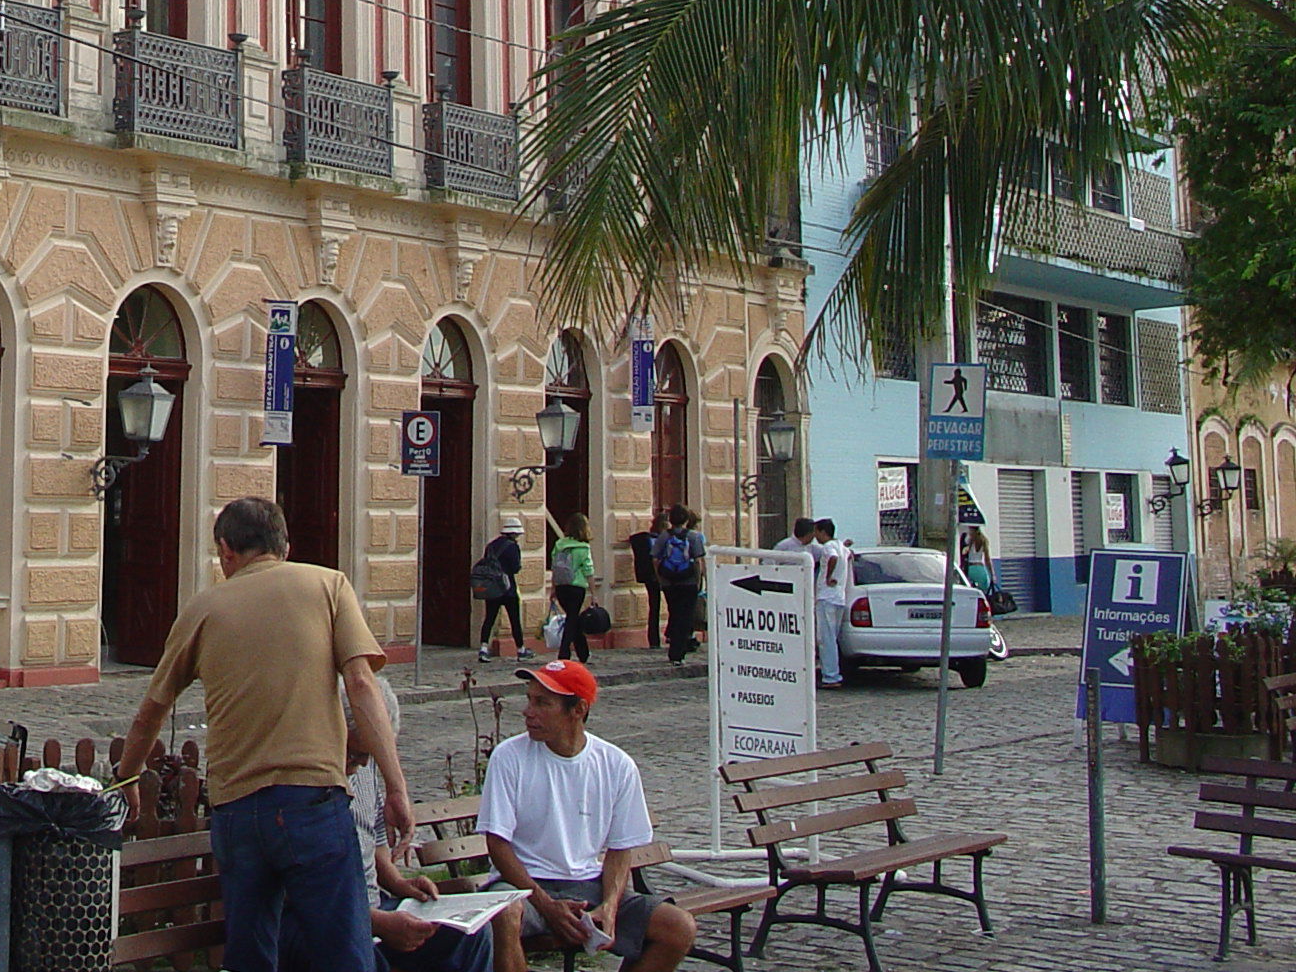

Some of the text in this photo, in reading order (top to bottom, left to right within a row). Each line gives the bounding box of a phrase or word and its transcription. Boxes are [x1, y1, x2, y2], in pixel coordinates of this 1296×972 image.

[416, 421, 426, 441] E
[929, 421, 983, 435] DEVAGAR
[928, 438, 982, 452] PEDESTRES
[726, 607, 801, 635] ILHA DO MEL
[1094, 607, 1170, 625] Informações
[737, 638, 784, 654] BILHETERIA
[737, 691, 775, 706] PASSEIOS
[734, 734, 797, 755] ECOPARANÁ
